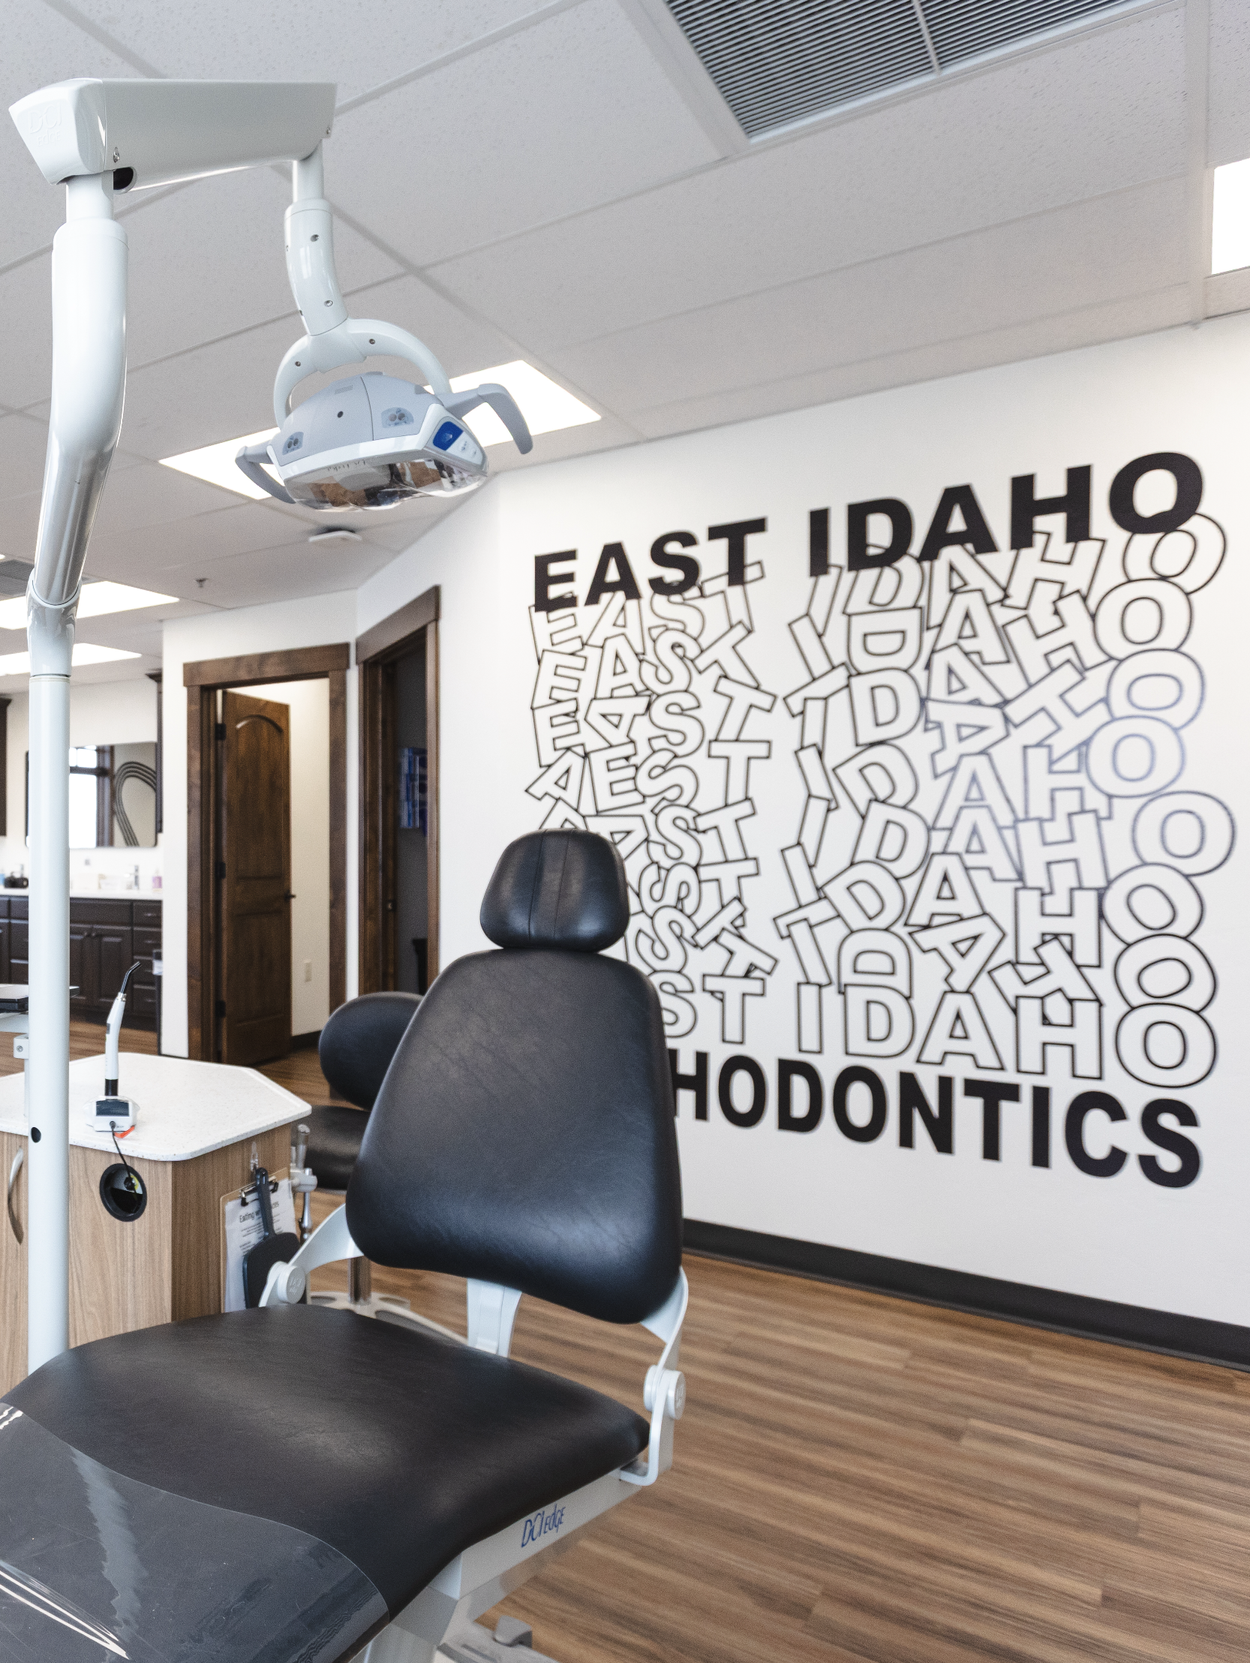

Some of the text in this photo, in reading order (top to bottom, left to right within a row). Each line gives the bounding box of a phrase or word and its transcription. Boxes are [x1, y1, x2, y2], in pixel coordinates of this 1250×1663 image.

[534, 452, 1204, 613] EAST IDAHO
[797, 983, 1218, 1088] IDAHO
[667, 1047, 1202, 1188] HODONTICS
